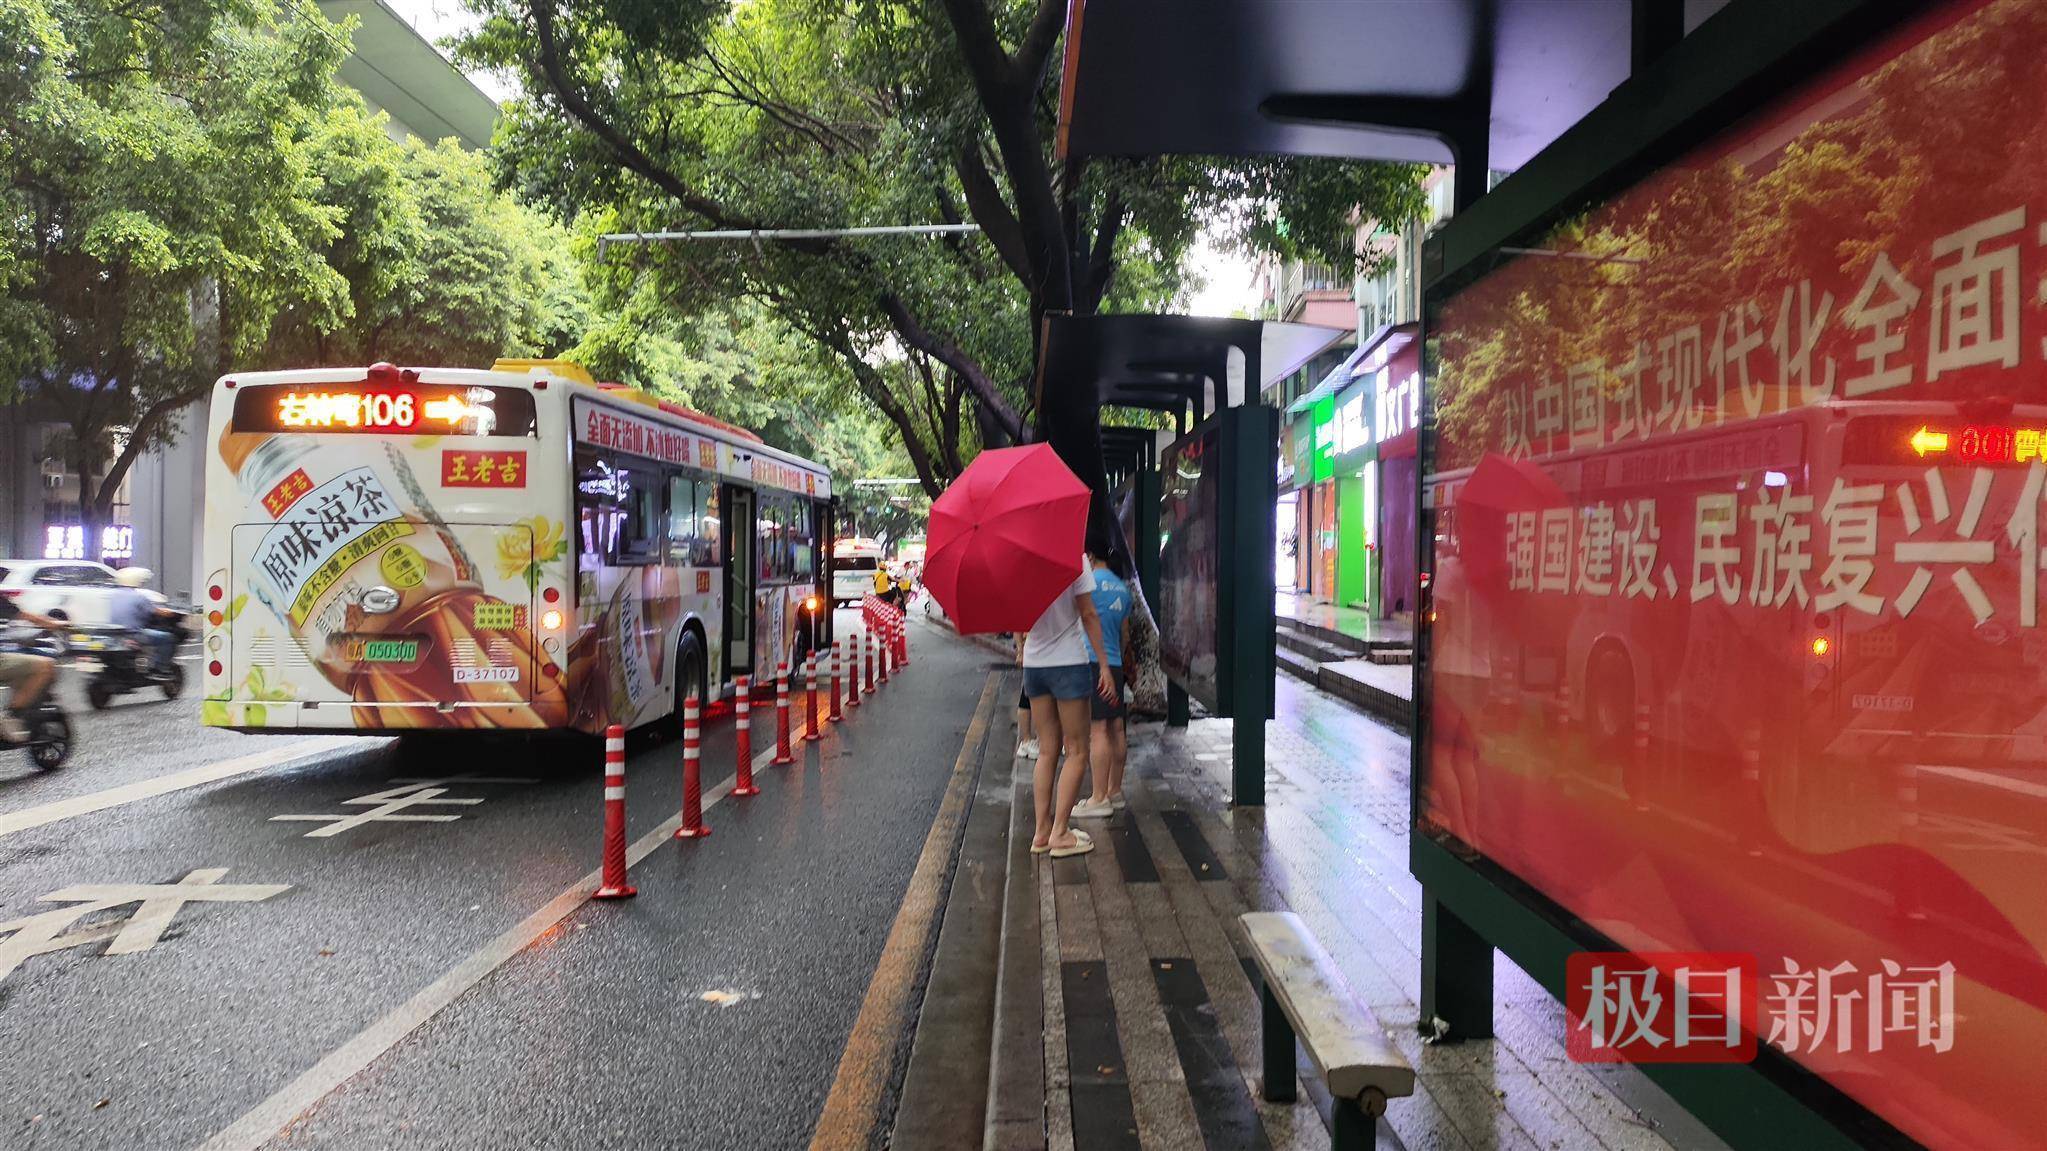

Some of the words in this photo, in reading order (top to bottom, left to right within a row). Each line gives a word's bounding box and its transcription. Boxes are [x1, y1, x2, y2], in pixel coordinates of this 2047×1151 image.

[1502, 204, 2047, 463] 以中国式现代化全面
[361, 393, 414, 426] 106
[587, 408, 643, 453] 全面无添加
[447, 454, 520, 484] 王老吉
[266, 474, 308, 515] 王老吉
[261, 475, 389, 593] 原味凉茶
[456, 669, 516, 681] D-37107
